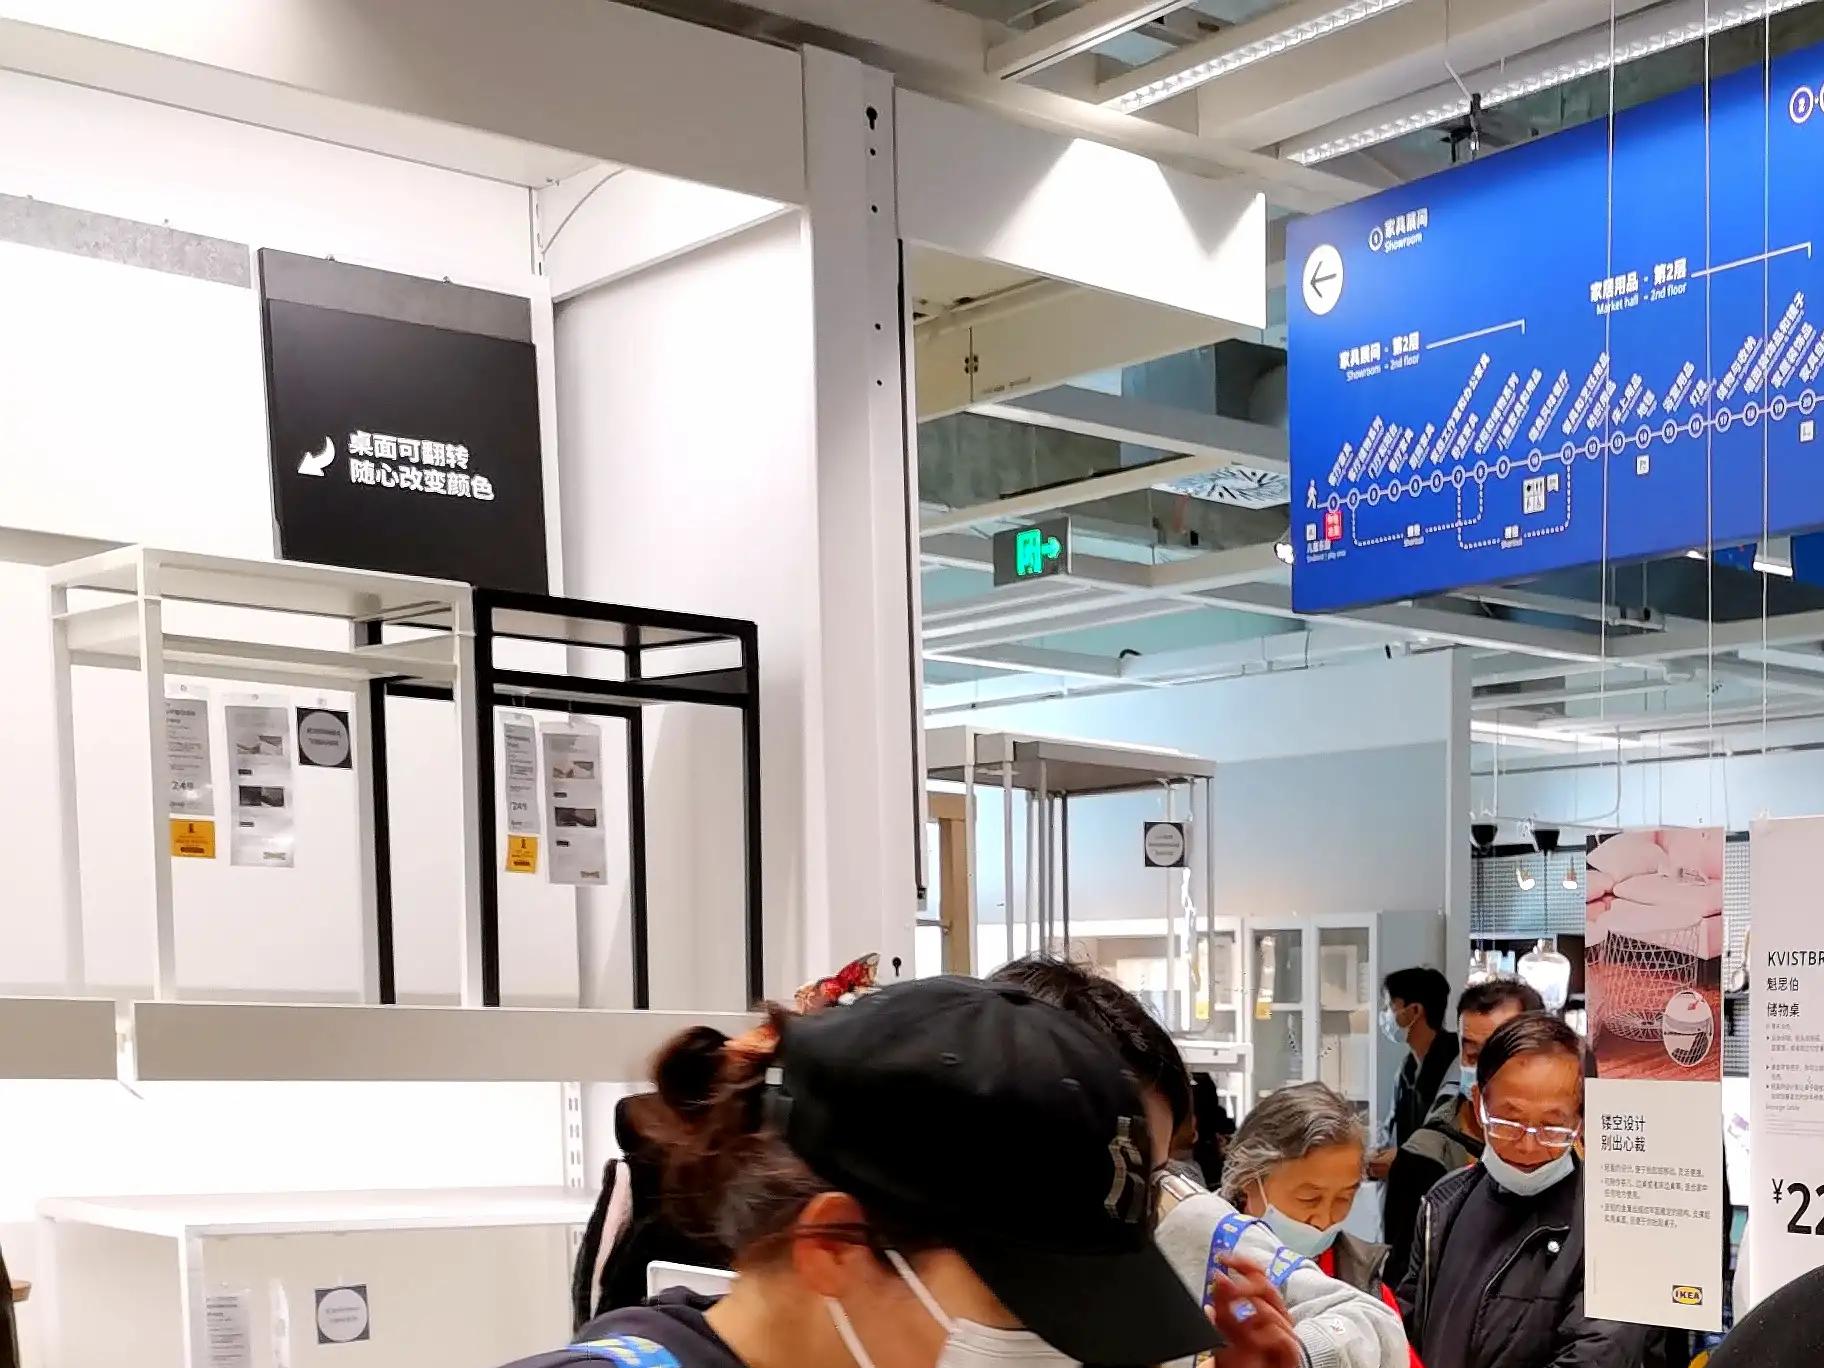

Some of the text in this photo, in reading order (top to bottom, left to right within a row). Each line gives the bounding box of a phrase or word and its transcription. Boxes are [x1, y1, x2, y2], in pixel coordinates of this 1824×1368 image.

[349, 430, 470, 469] 桌面可翻转
[349, 458, 495, 502] 随心改变颜色
[1766, 1002, 1800, 1018] 储物桌
[1601, 1114, 1646, 1132] 镂空设计
[1601, 1135, 1646, 1153] 别出心裁
[1675, 1290, 1700, 1300] IKEA
